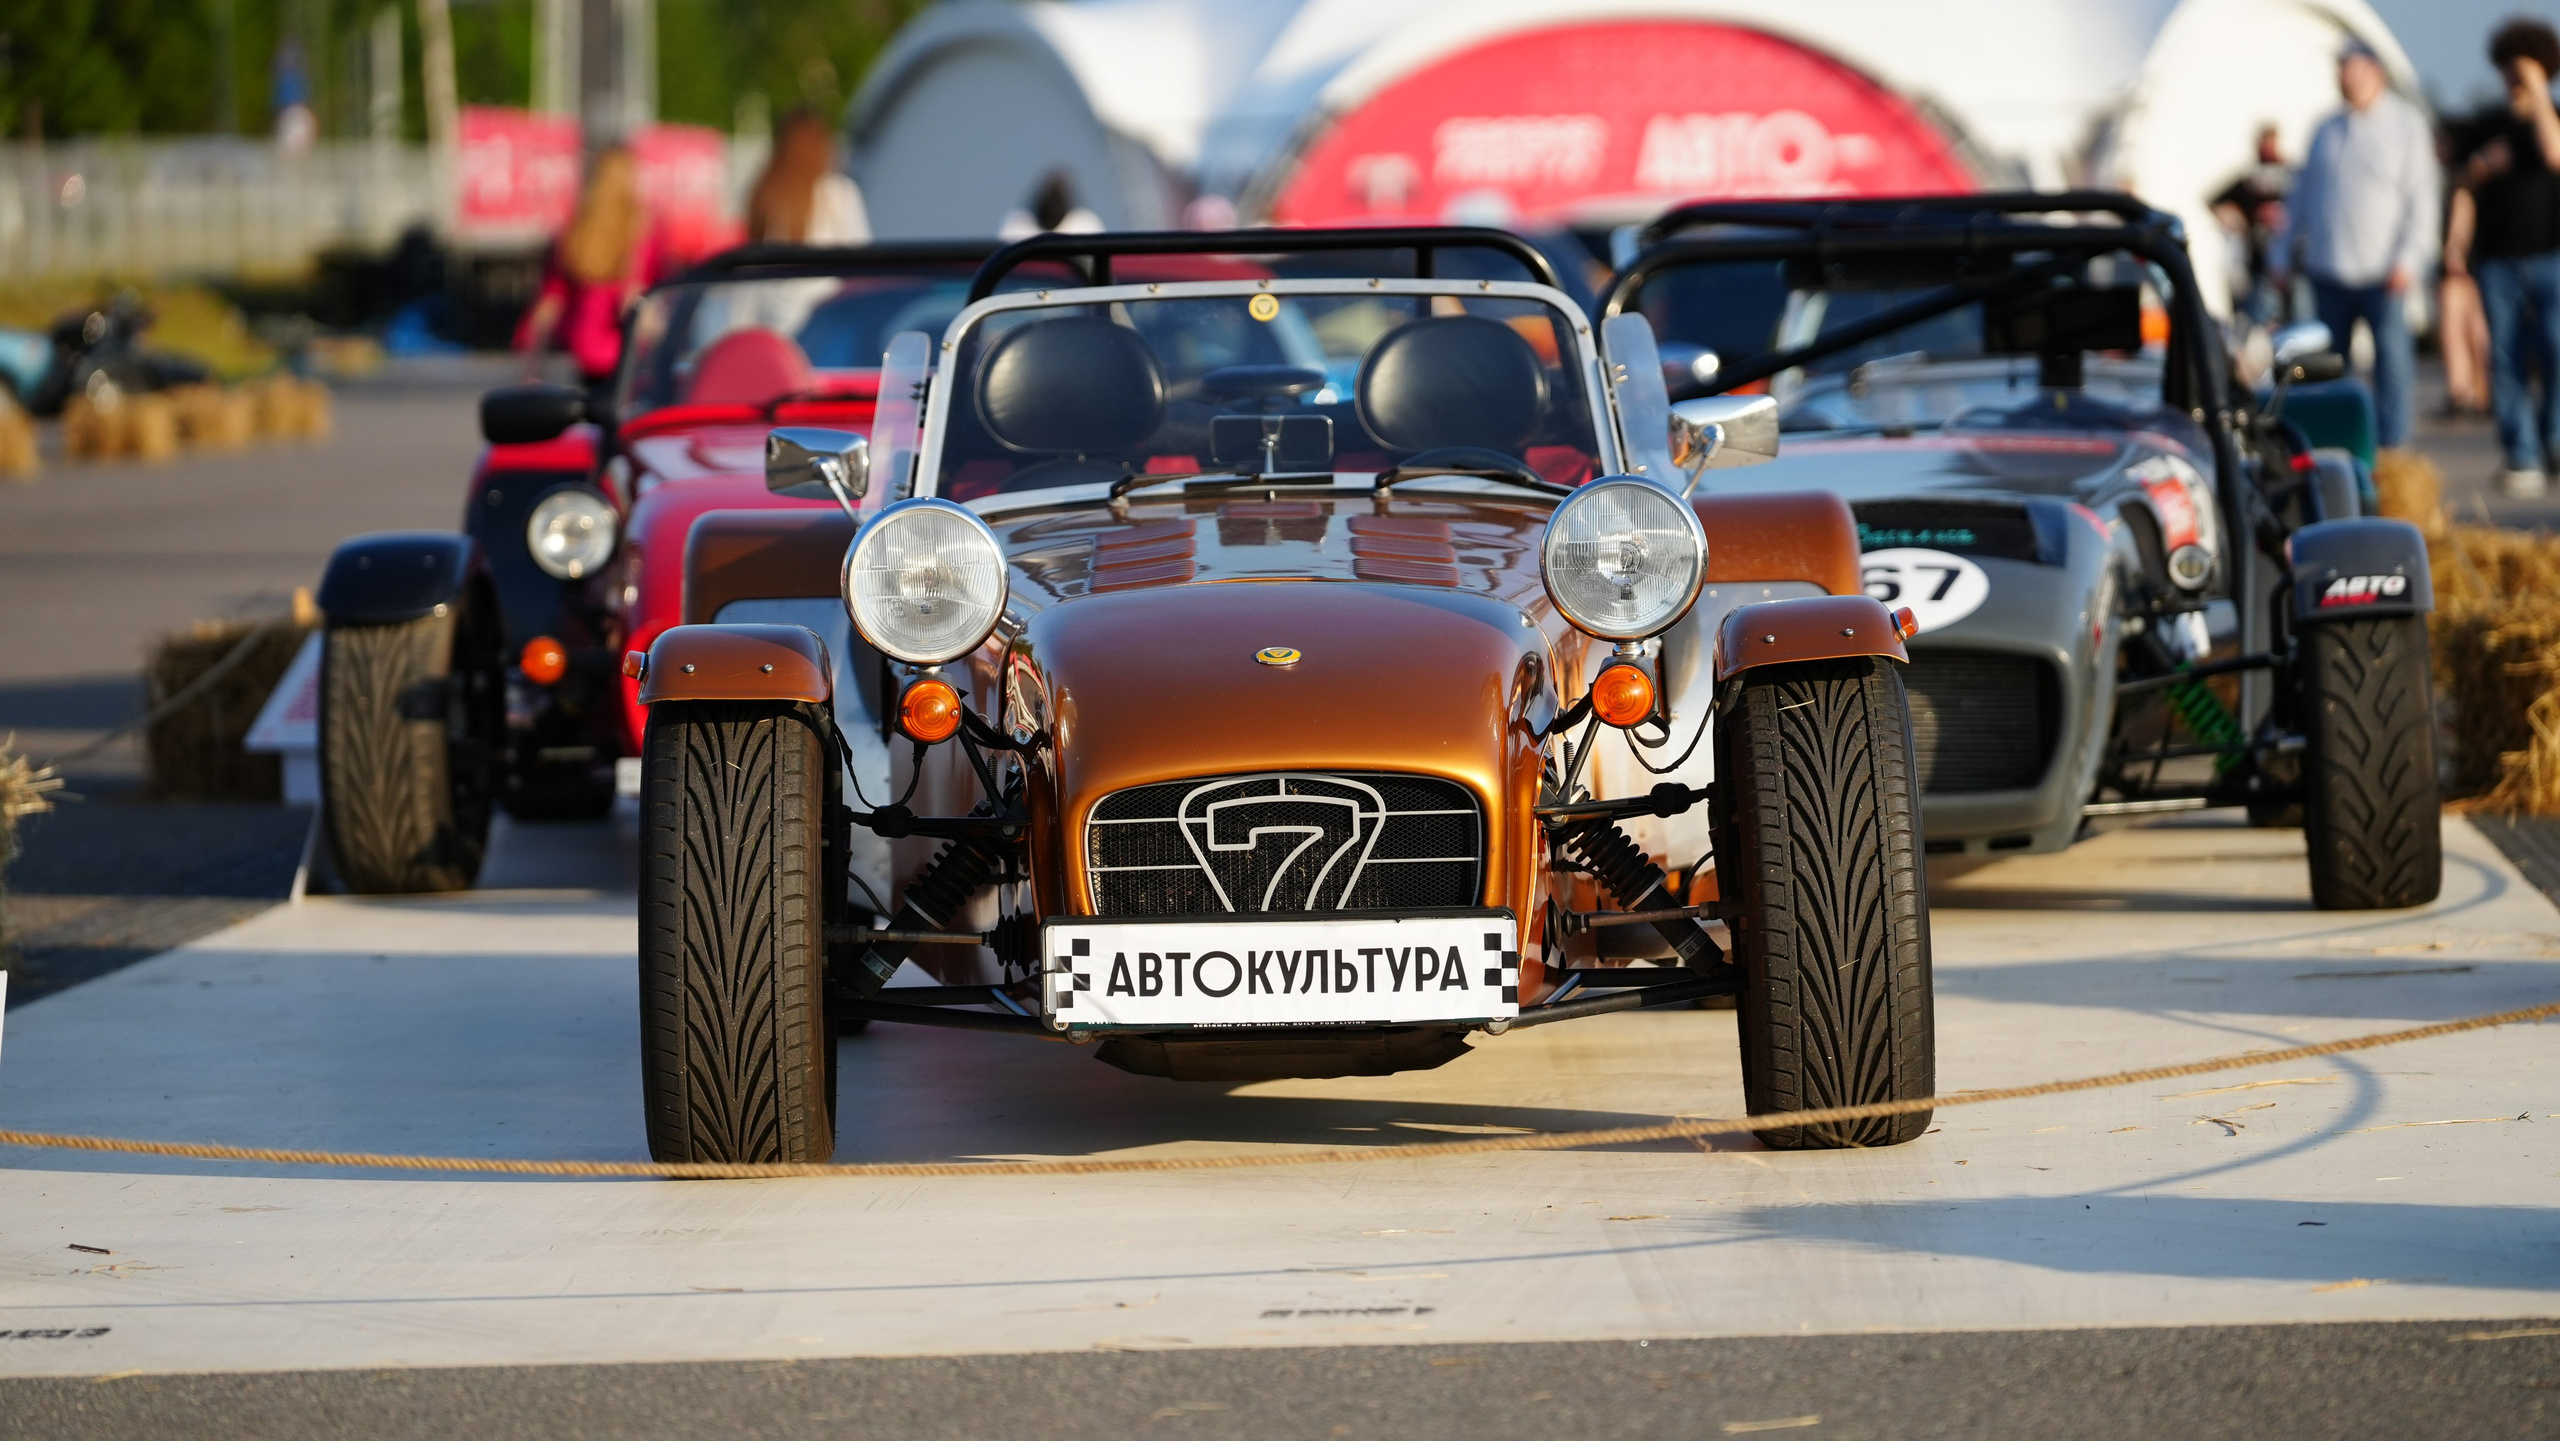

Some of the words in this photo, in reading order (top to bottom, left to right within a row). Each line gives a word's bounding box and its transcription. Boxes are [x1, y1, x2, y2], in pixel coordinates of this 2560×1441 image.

[1863, 564, 1962, 601] 67
[1207, 794, 1361, 911] 7
[1106, 945, 1469, 998] АВТОКУЛЬТУРА
